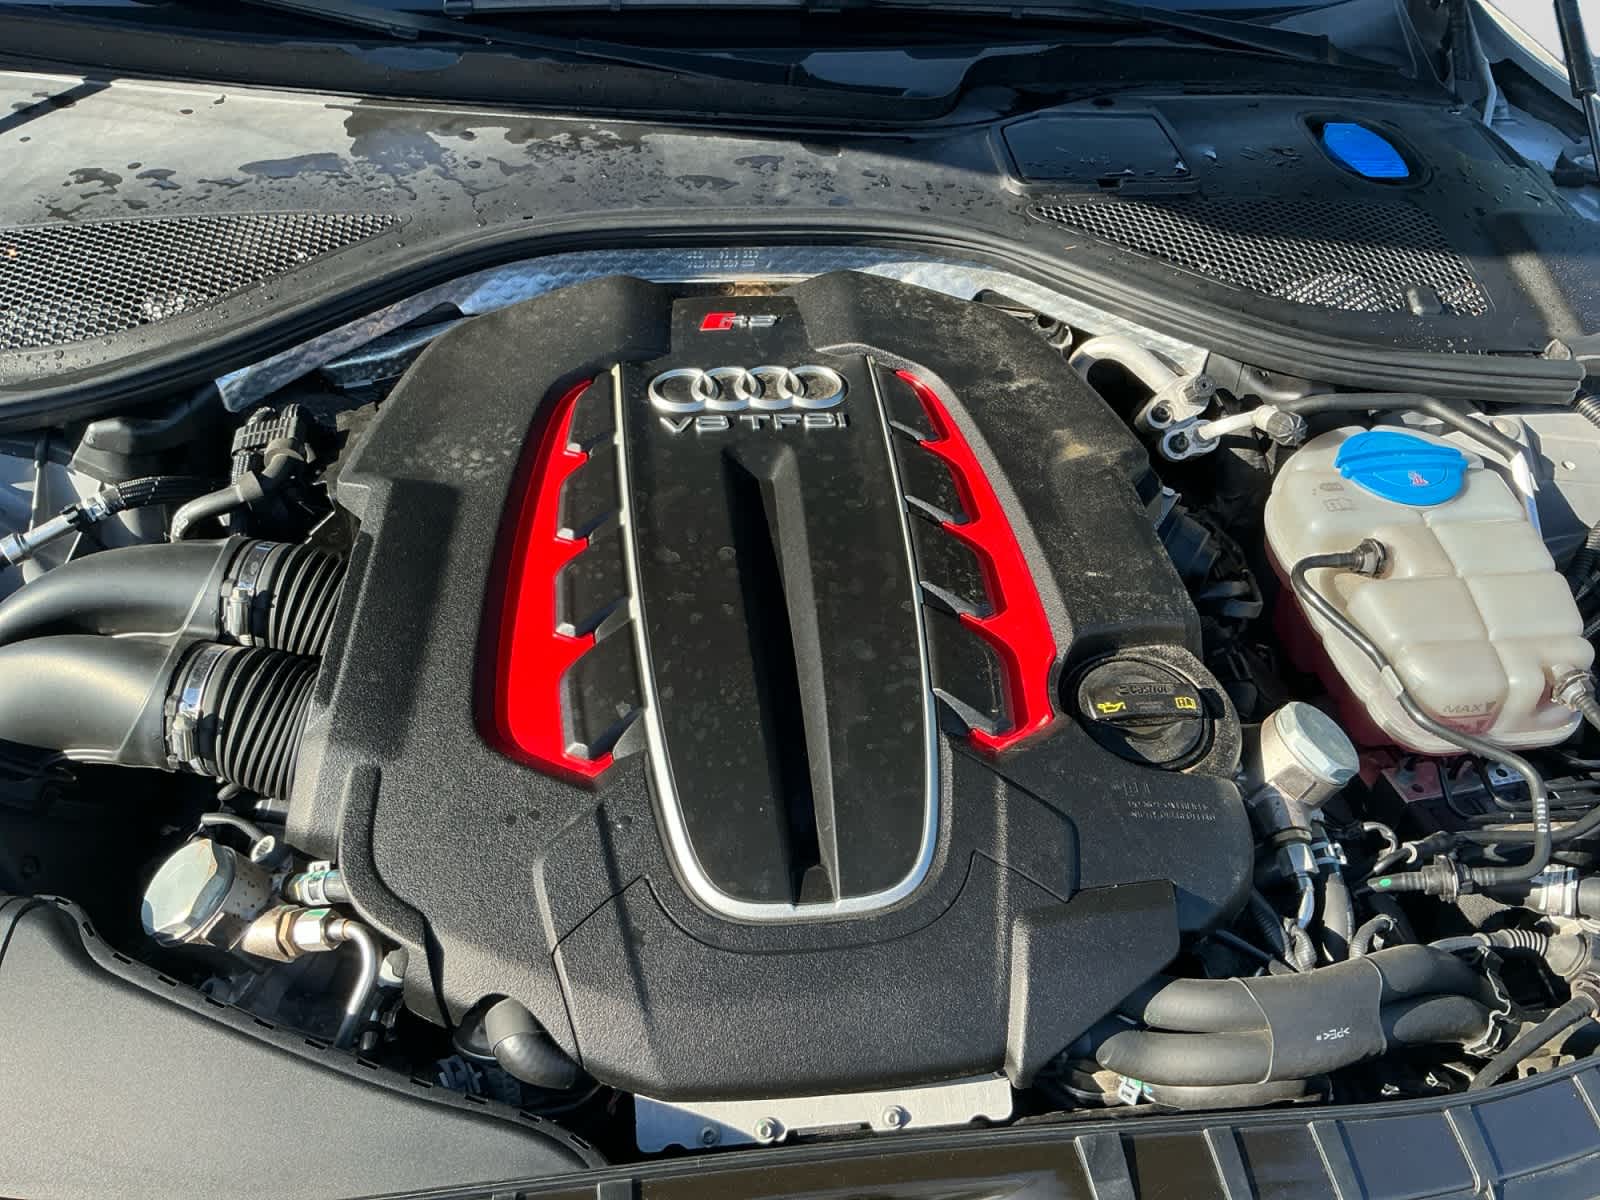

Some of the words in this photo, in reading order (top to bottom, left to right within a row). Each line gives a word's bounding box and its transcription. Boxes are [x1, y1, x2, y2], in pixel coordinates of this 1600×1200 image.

[659, 415, 730, 433] V8
[739, 412, 847, 431] TFSI
[1128, 683, 1169, 695] Castrol
[1442, 703, 1483, 713] MAX
